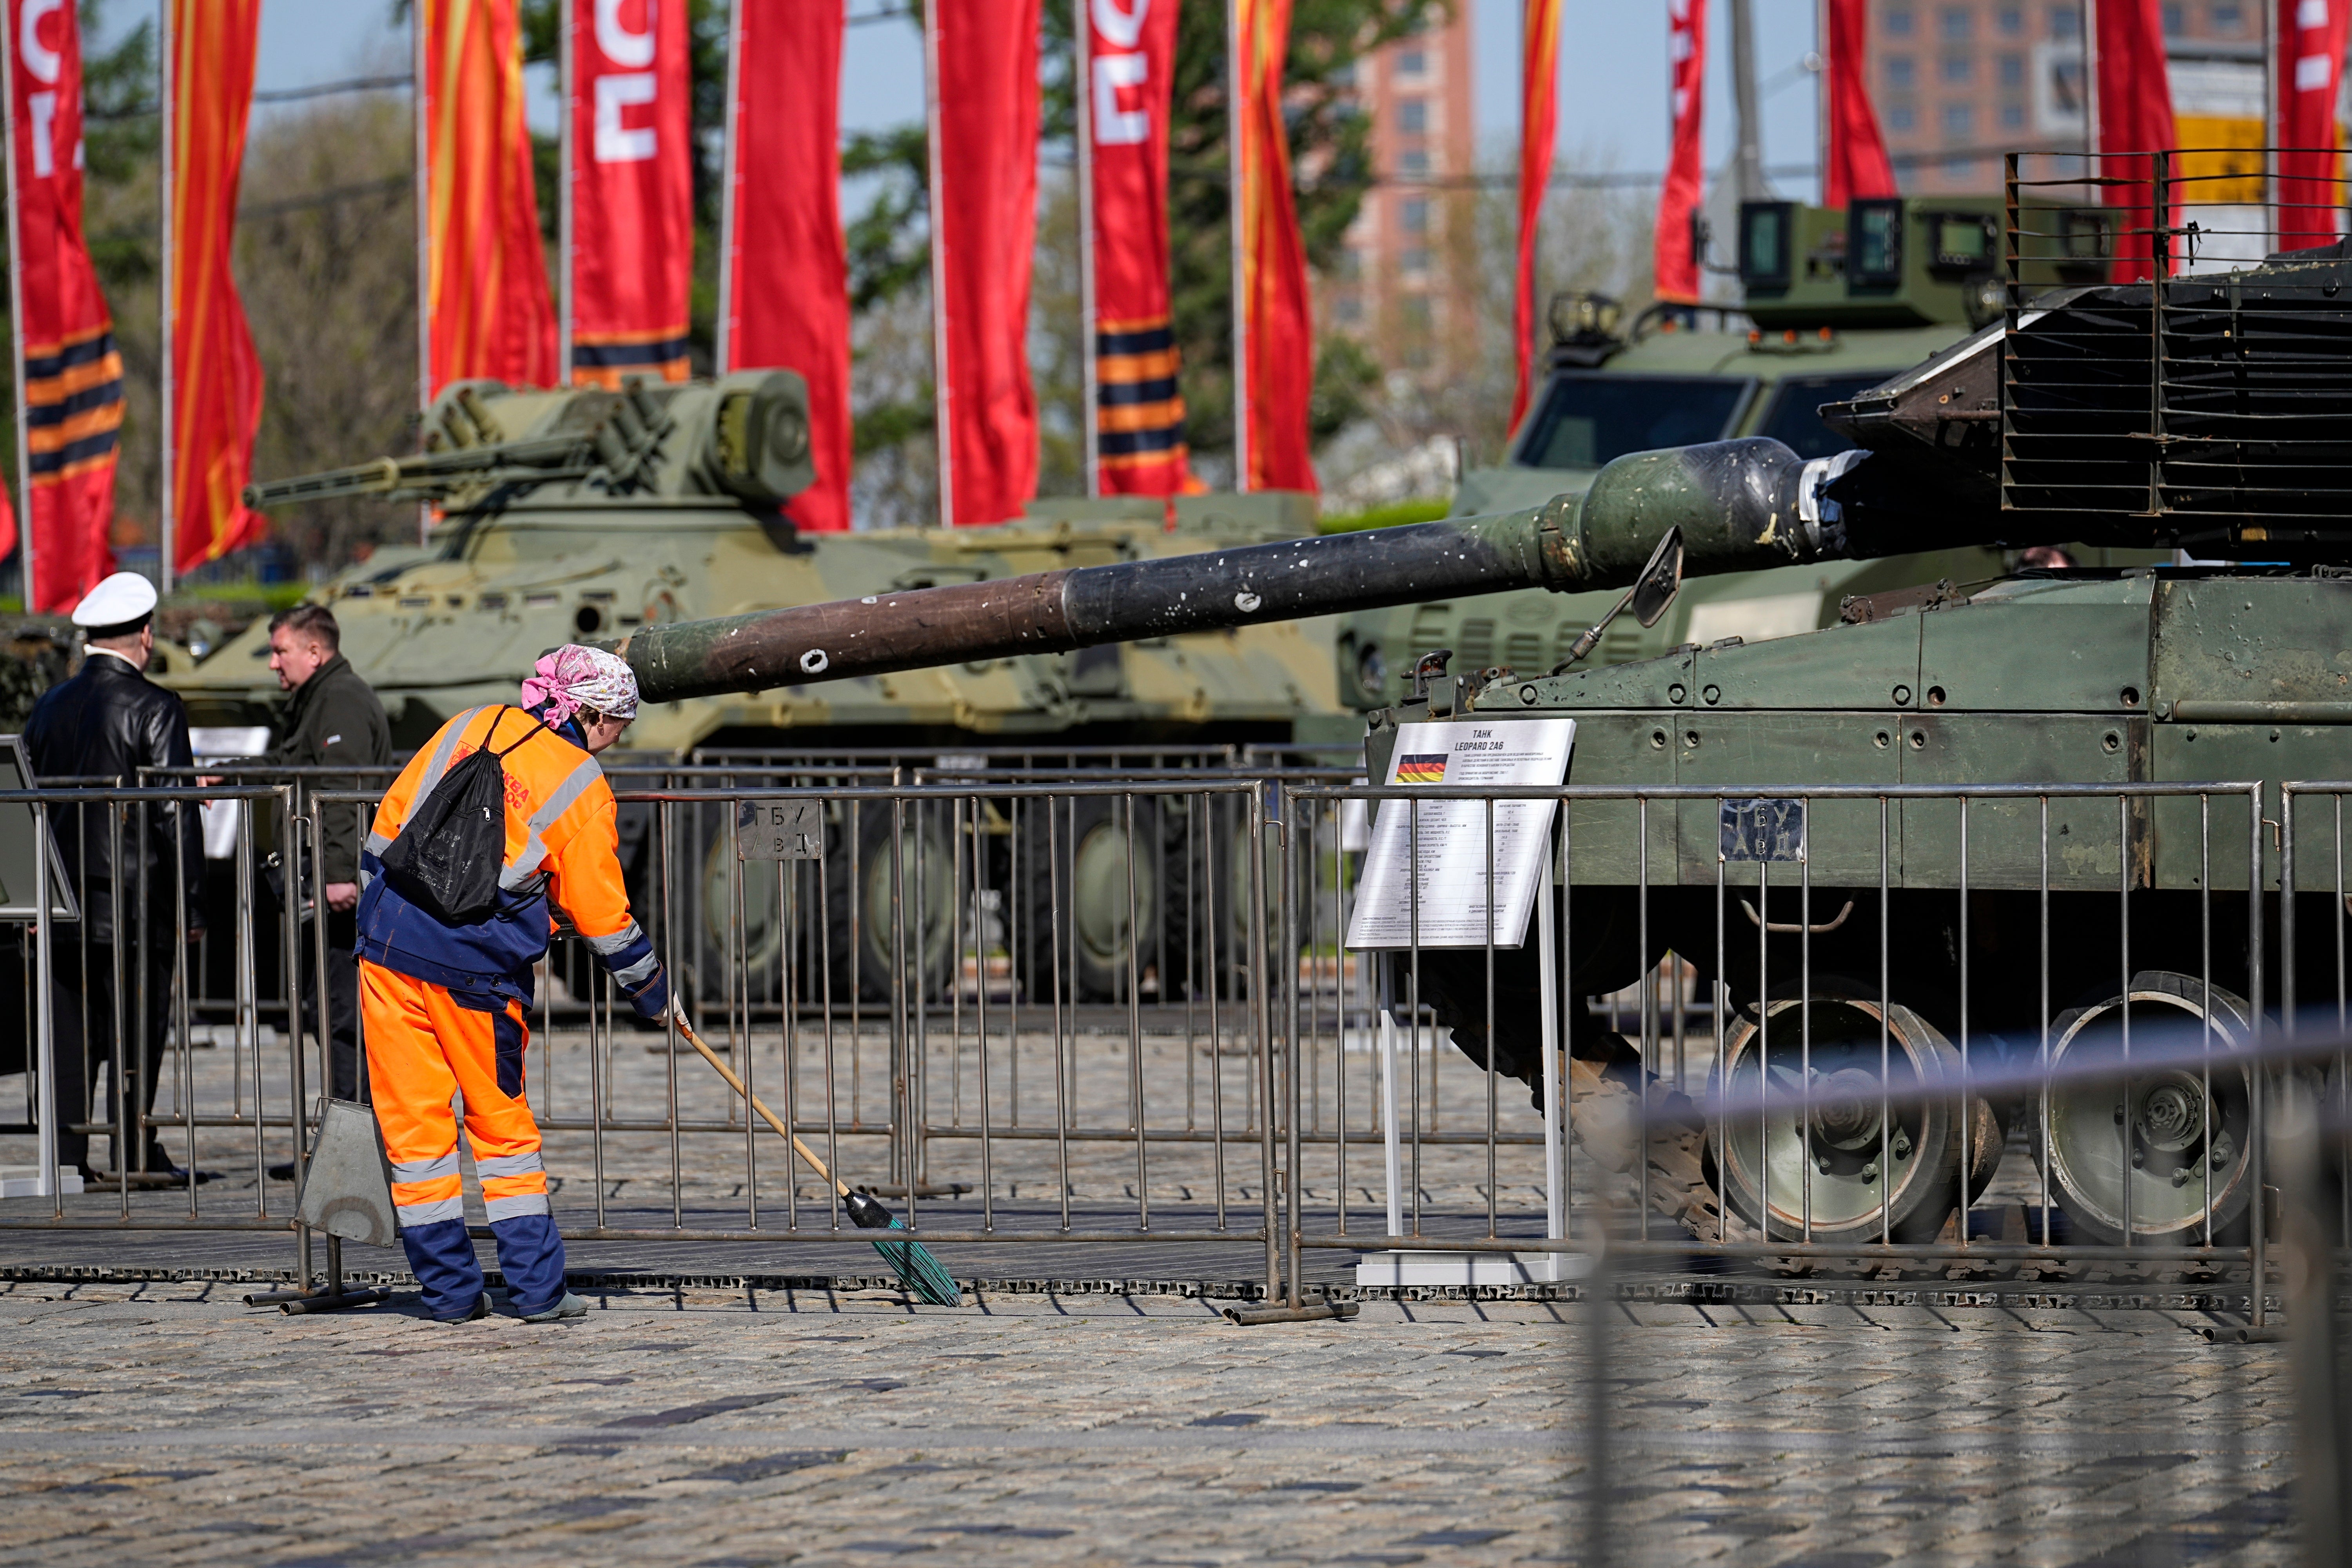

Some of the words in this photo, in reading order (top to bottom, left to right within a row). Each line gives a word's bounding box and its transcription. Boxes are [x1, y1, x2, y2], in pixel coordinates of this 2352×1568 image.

[1473, 730, 1493, 738] ТАНК
[1455, 742, 1487, 751] LEOPARD
[1489, 742, 1504, 750] 2A6
[755, 807, 805, 826] ГБУ
[1736, 806, 1789, 827] ГБУ
